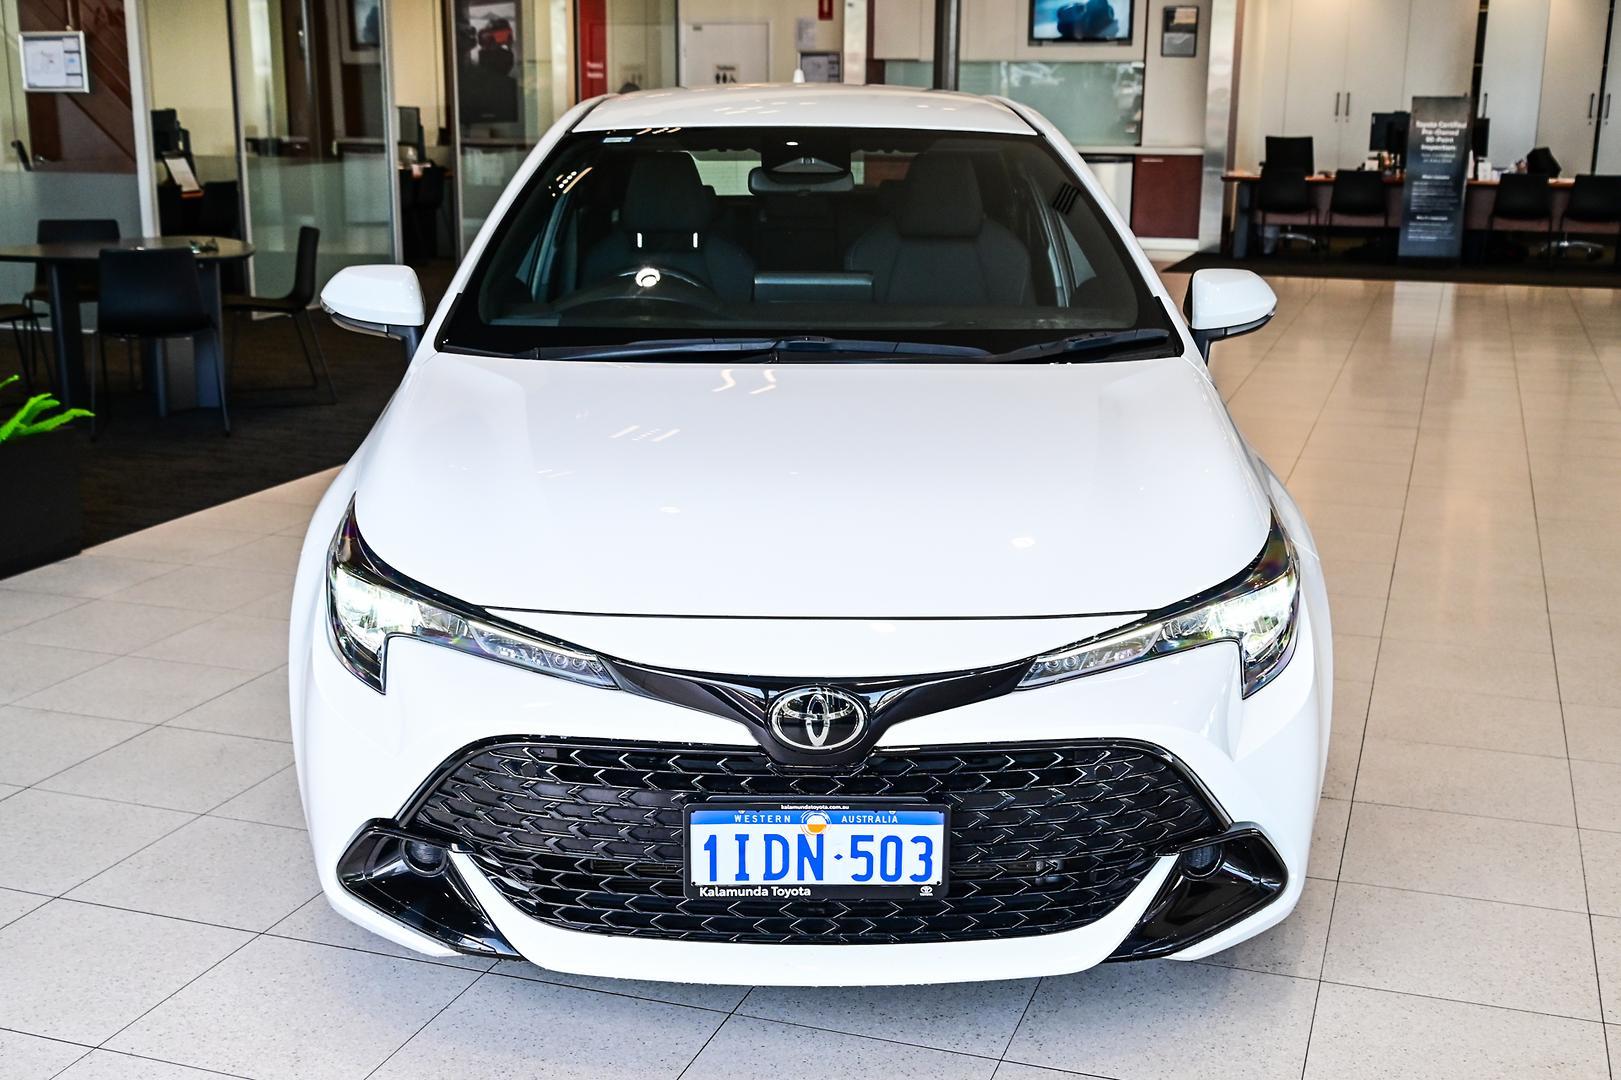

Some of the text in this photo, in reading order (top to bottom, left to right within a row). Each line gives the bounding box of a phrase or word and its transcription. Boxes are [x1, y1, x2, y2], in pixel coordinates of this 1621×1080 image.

[734, 814, 899, 824] WESTERN AUSTRALIA
[699, 886, 812, 898] Kalamunda Toyota
